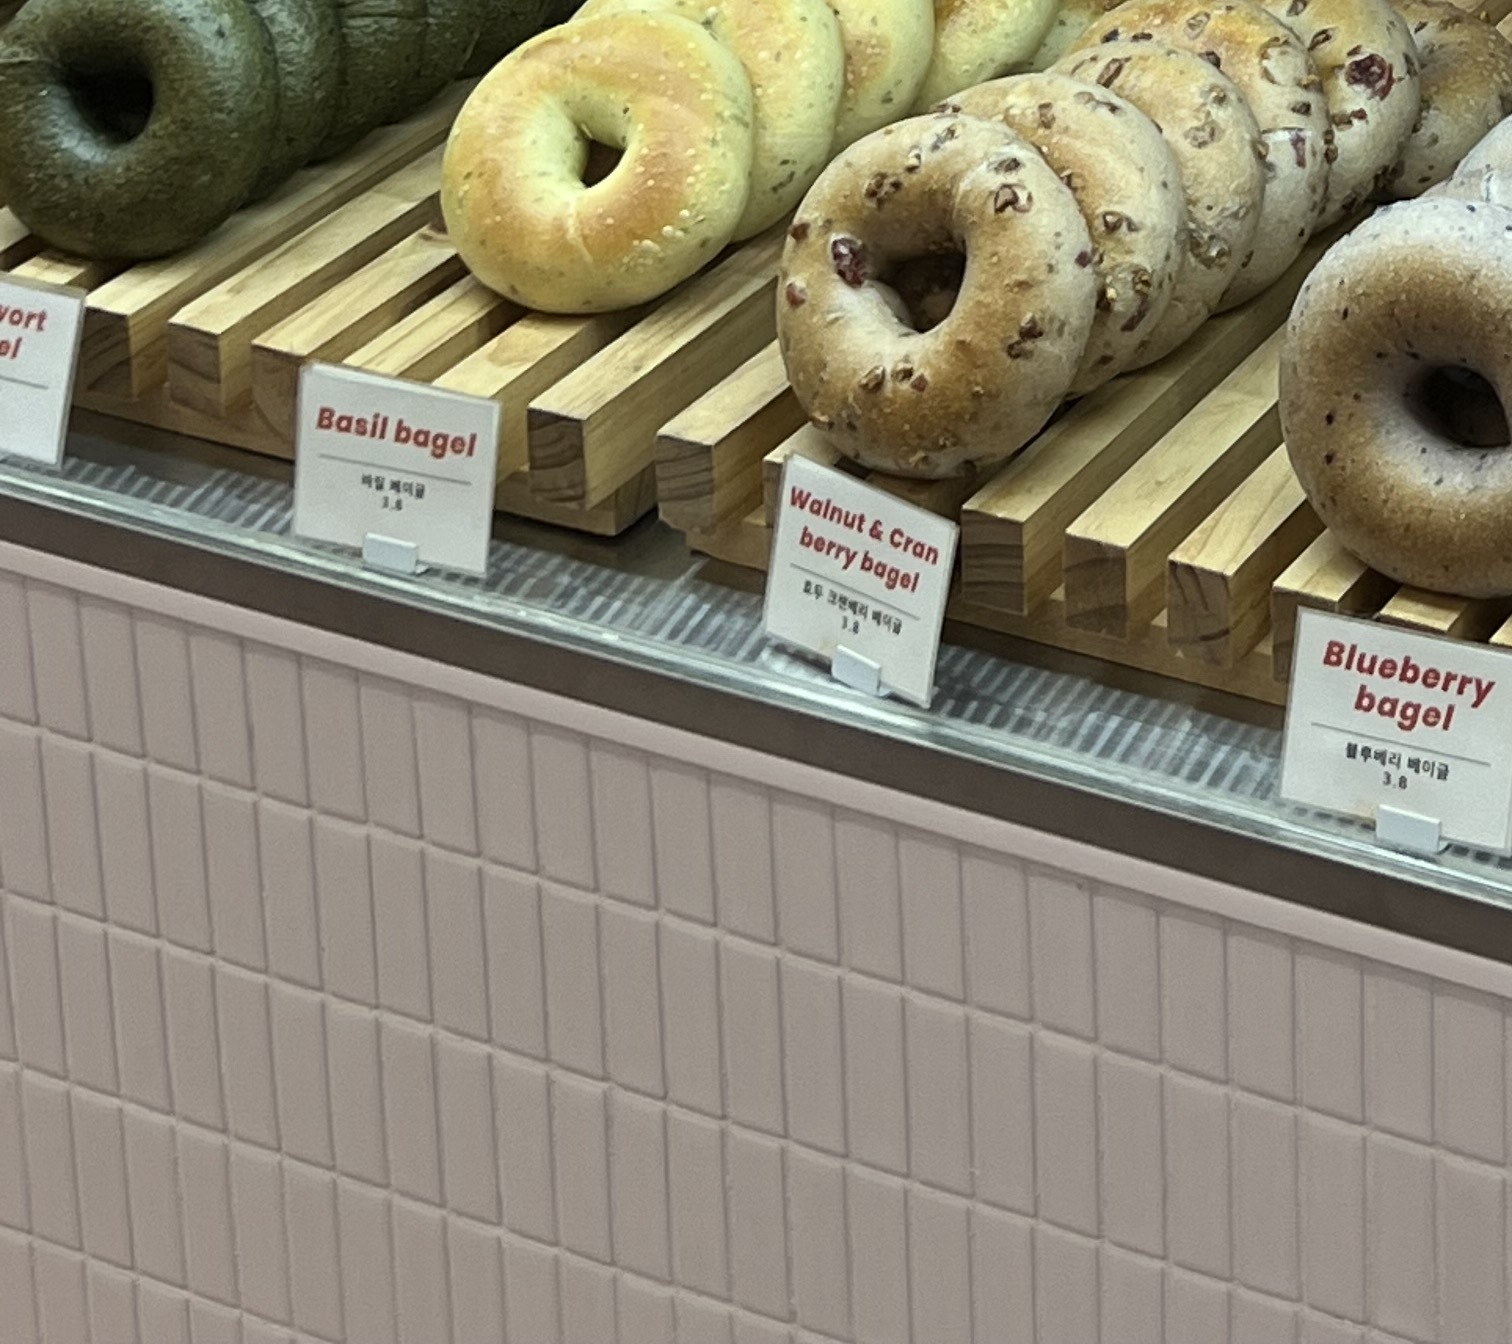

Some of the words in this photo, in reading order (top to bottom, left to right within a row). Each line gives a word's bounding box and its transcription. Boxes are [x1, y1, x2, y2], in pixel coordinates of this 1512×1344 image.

[316, 406, 389, 440] Basil
[394, 418, 477, 459] bagel
[389, 479, 426, 499] 베이글
[790, 486, 866, 534] Walnut
[868, 519, 884, 543] &
[889, 527, 939, 565] Cran
[799, 526, 858, 570] berry
[860, 550, 920, 593] bagel
[803, 579, 824, 600] 호두
[827, 588, 869, 620] 크랜베리
[872, 609, 903, 636] 베이글
[1322, 639, 1496, 709] Blueberry
[1354, 684, 1455, 732] bagel
[1346, 742, 1402, 770] 블루베리
[1407, 756, 1450, 781] 베이글
[1382, 771, 1408, 790] 3.8
